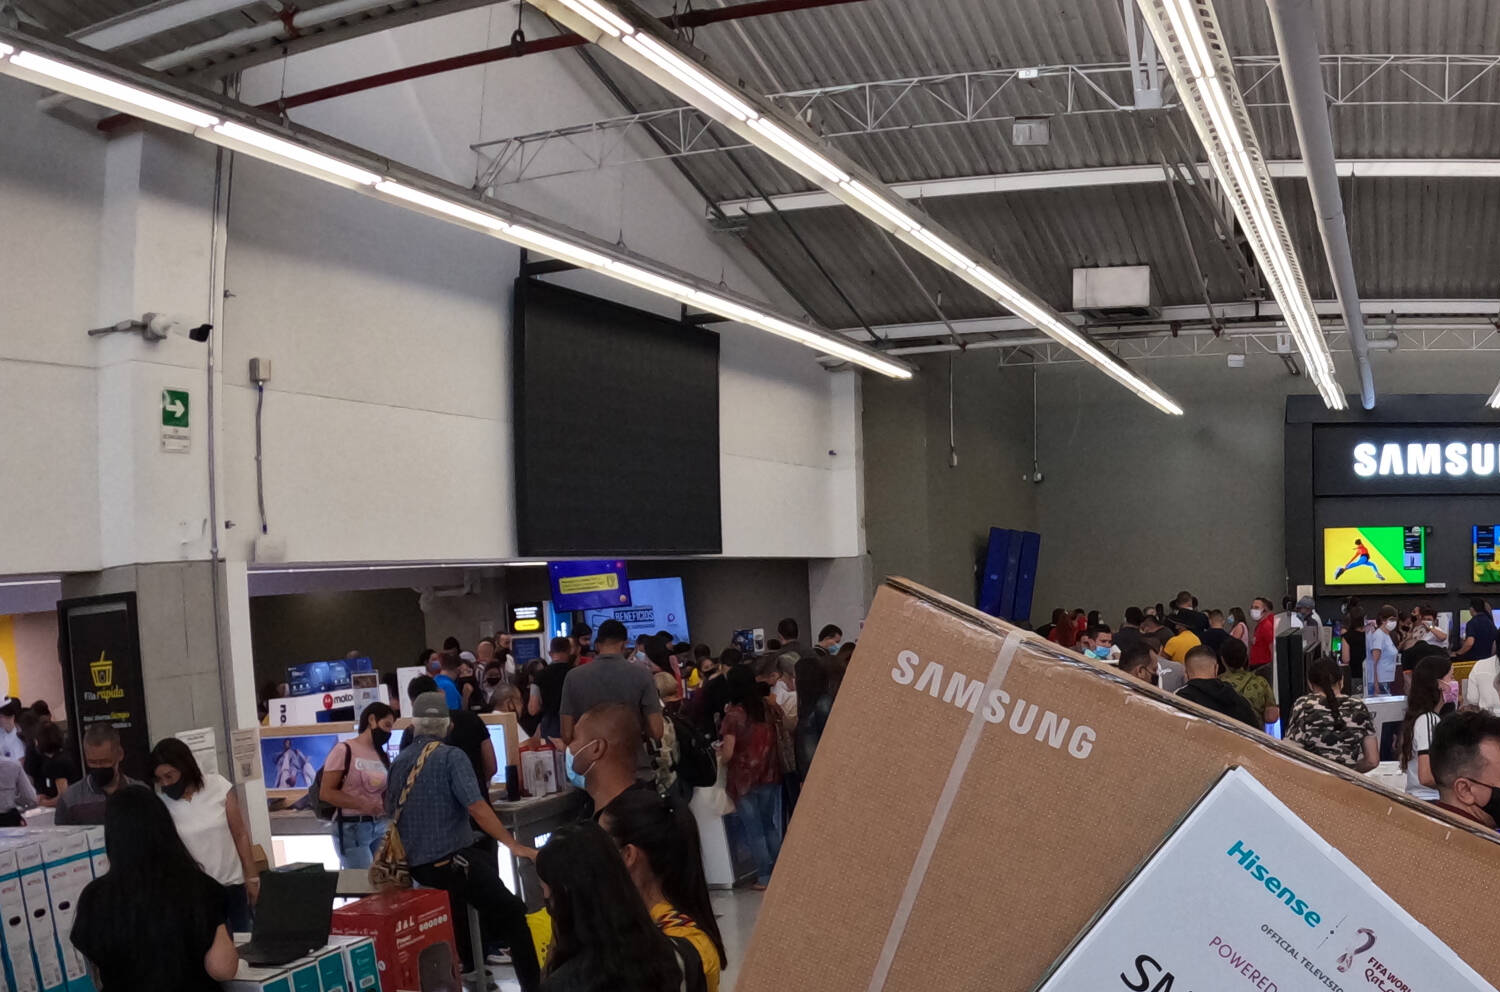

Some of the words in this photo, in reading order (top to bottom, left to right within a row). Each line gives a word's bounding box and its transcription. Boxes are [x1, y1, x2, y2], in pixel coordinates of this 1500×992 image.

[333, 693, 354, 704] moto
[891, 649, 1098, 760] SAMSUNG
[1226, 839, 1323, 929] Hisense
[1260, 923, 1300, 960] OFFICIAL
[1367, 956, 1387, 977] FIFA
